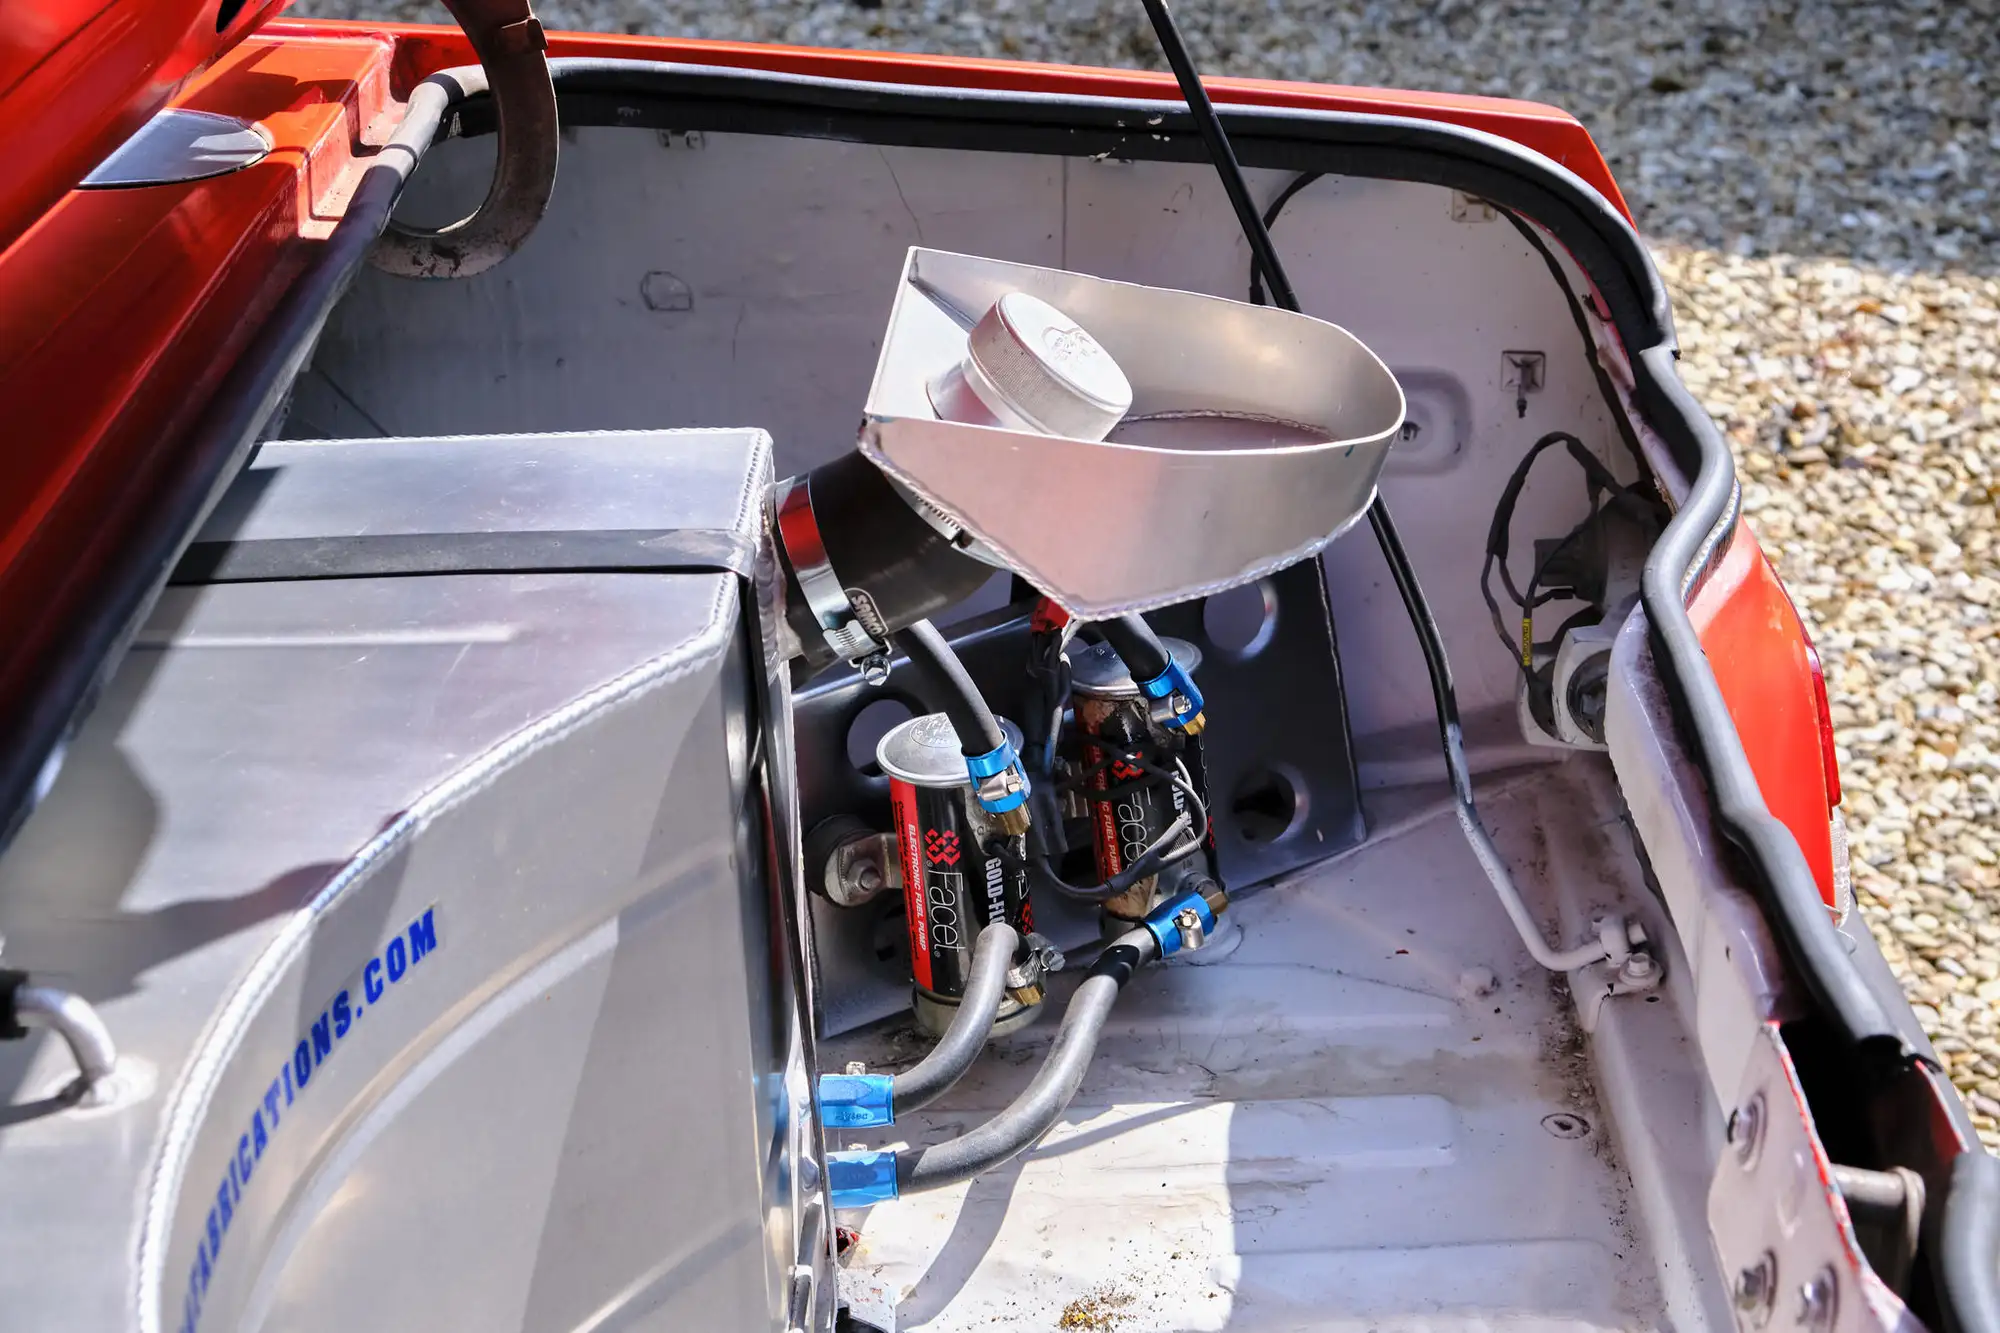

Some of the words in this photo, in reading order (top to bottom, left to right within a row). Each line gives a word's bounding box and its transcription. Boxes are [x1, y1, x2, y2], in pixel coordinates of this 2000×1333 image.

[851, 595, 883, 635] SAMCO
[1104, 814, 1114, 841] FUEL
[908, 823, 921, 890] ELECTRONIC
[915, 891, 924, 917] FUEL
[928, 869, 966, 953] Facet
[918, 921, 927, 951] PUMP
